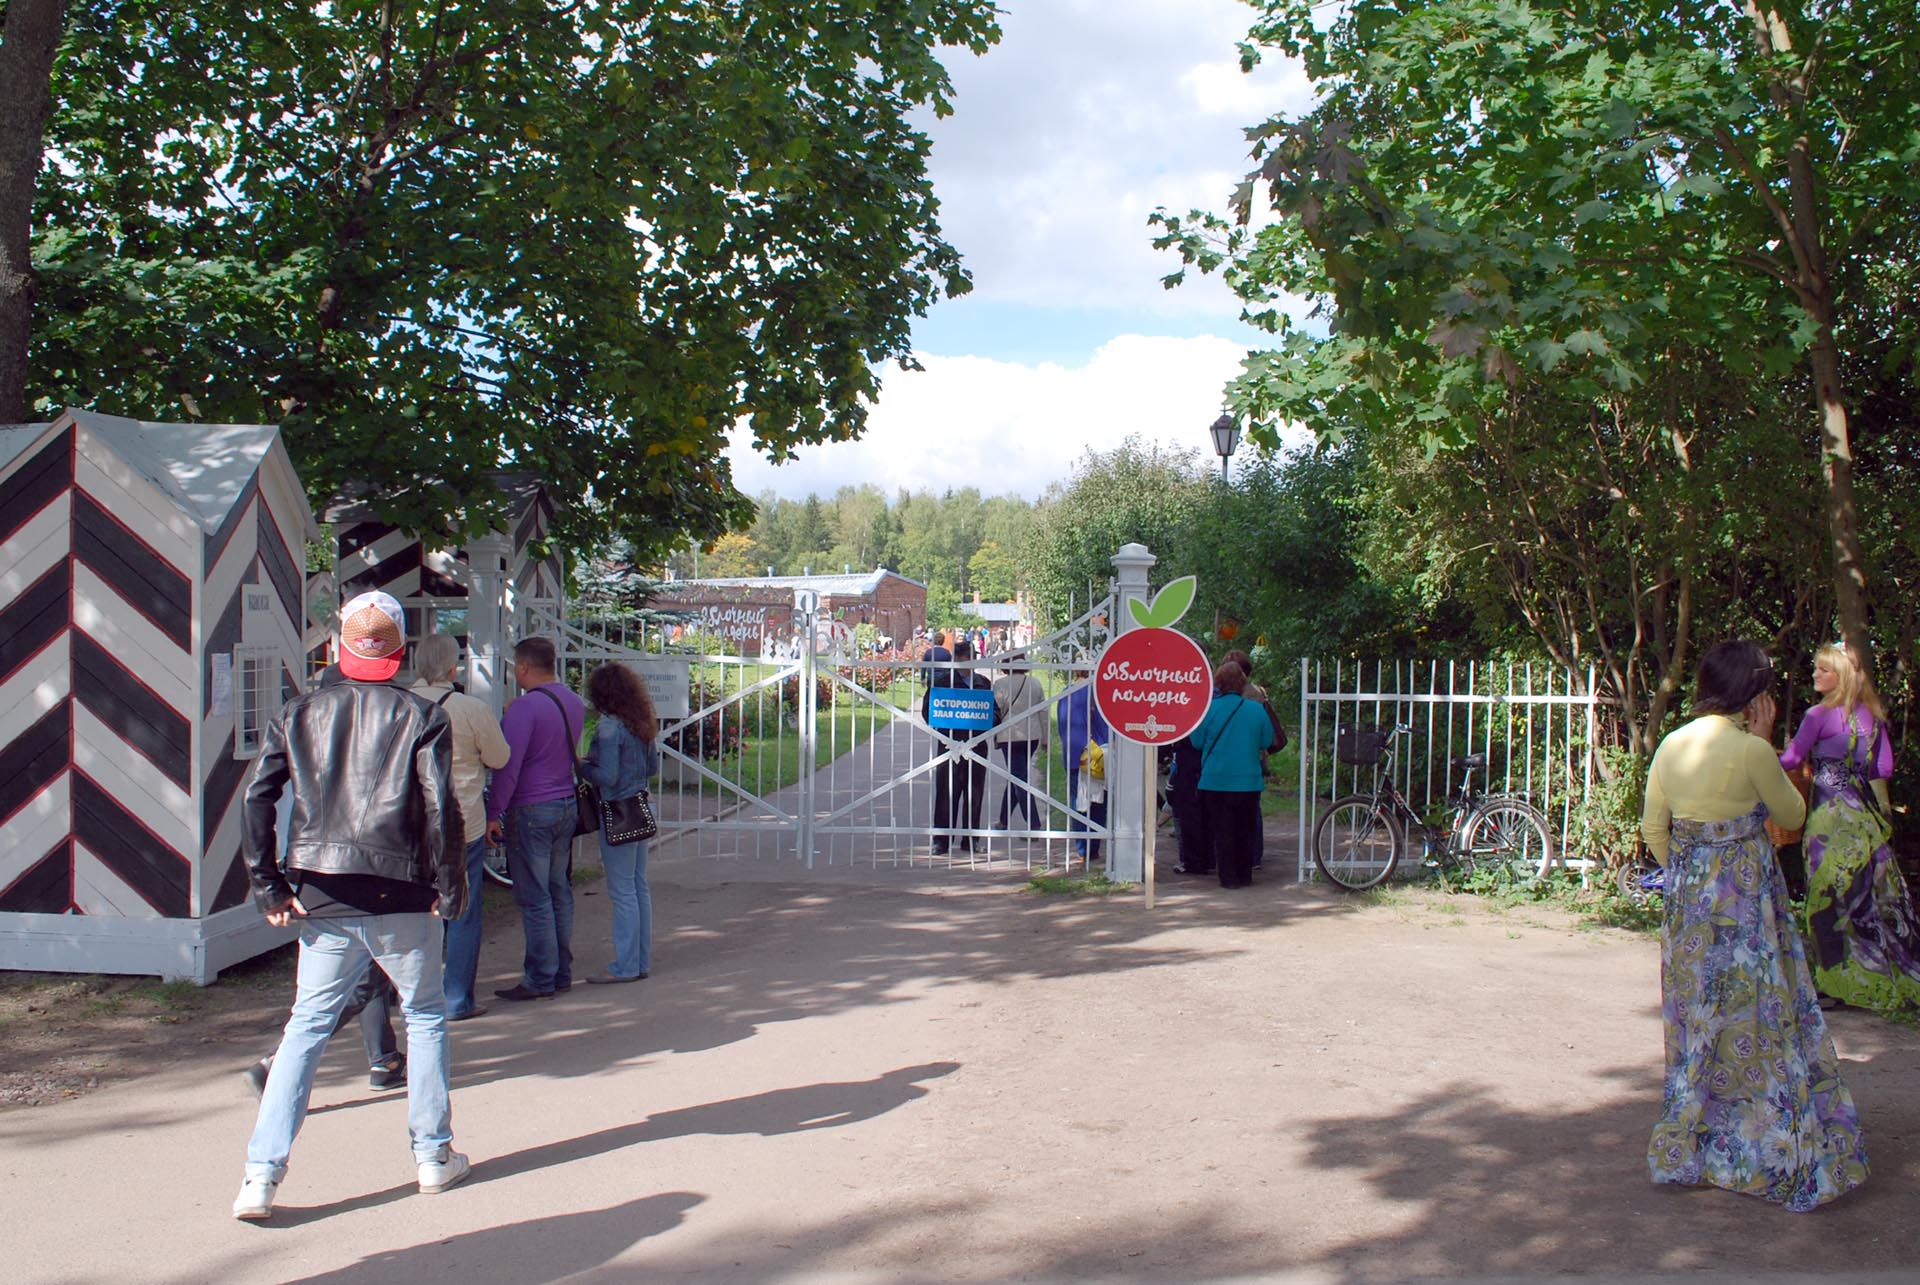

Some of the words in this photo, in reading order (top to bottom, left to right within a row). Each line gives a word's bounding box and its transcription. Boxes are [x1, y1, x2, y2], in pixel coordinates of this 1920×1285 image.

[1102, 661, 1202, 684] Яблочный
[933, 698, 990, 710] ОСТОРОЖНО
[1112, 688, 1191, 708] полдень
[932, 709, 954, 719] ЗЛАЯ
[955, 710, 989, 721] СОБАКА!
